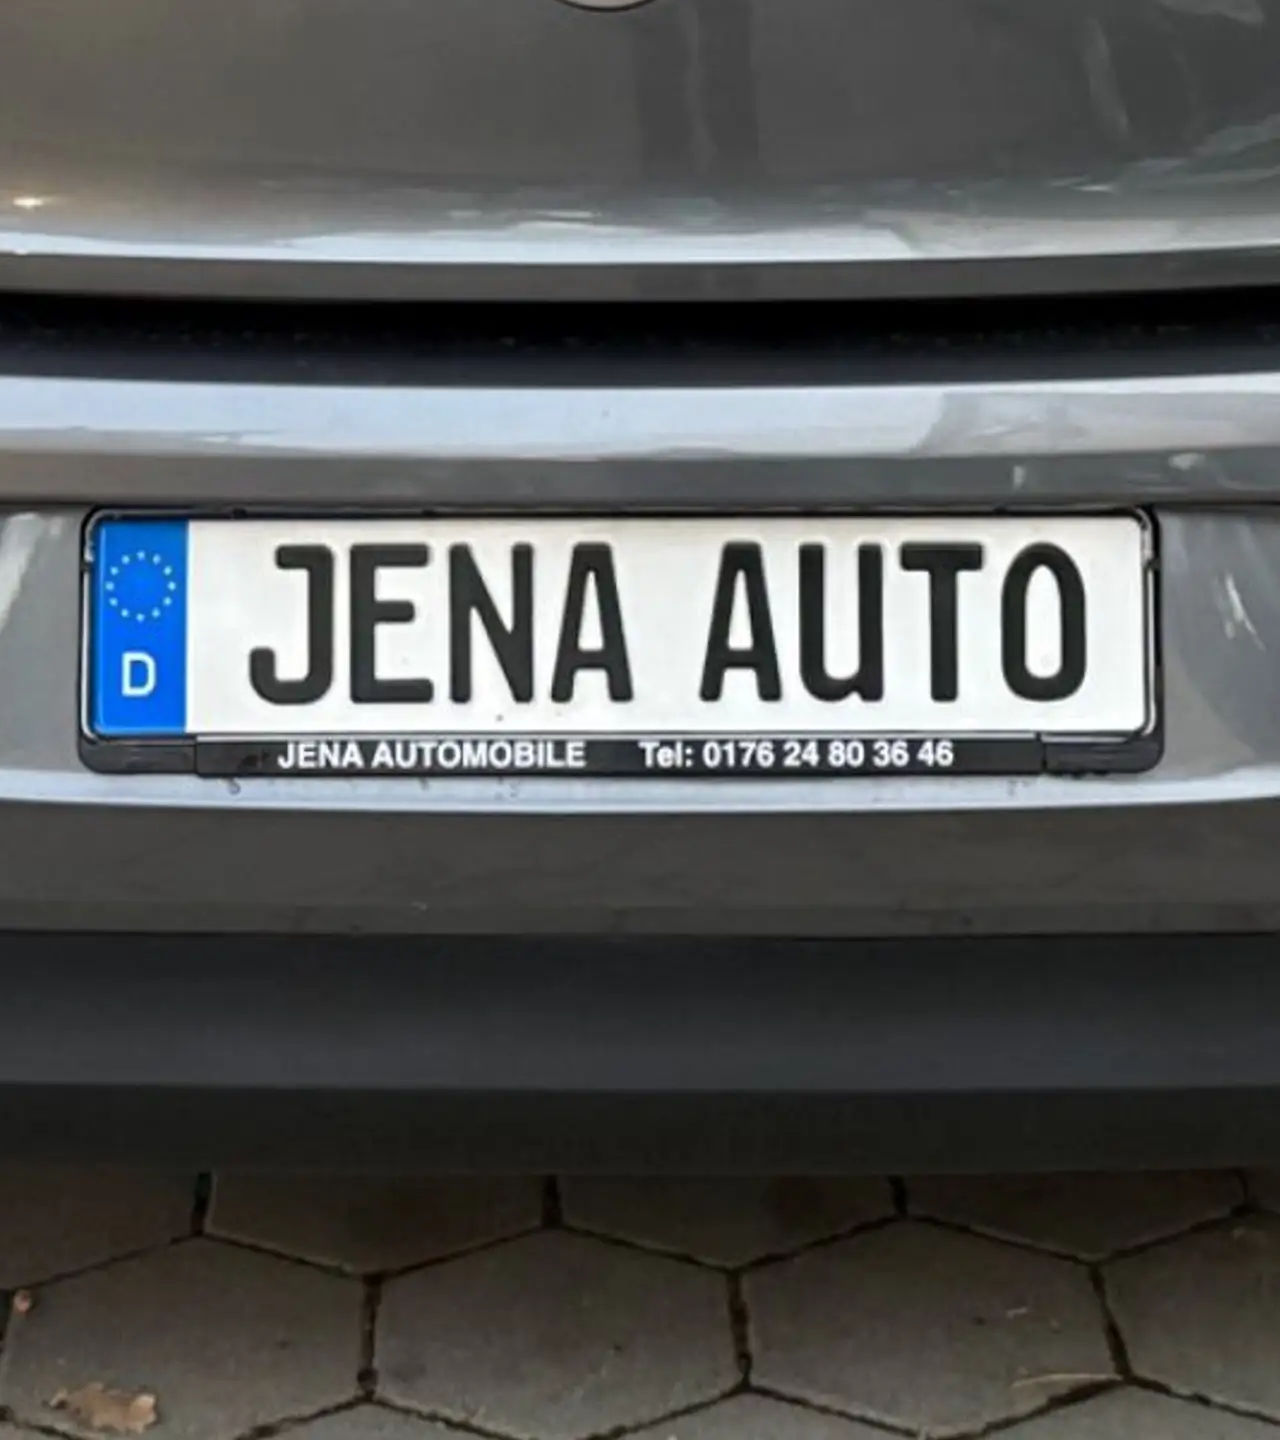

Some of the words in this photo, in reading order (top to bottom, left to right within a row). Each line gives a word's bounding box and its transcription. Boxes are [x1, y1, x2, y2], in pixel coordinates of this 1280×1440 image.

[248, 541, 634, 705] JENA
[698, 540, 1088, 703] AUTO
[121, 652, 158, 697] D
[277, 741, 364, 769] JENA
[372, 741, 586, 769] AUTOMOBILE
[639, 740, 693, 768] Tel:
[702, 740, 775, 768] 0176
[782, 740, 820, 768] 24
[827, 740, 866, 768] 80
[872, 740, 910, 768] 36
[917, 740, 955, 768] 46
